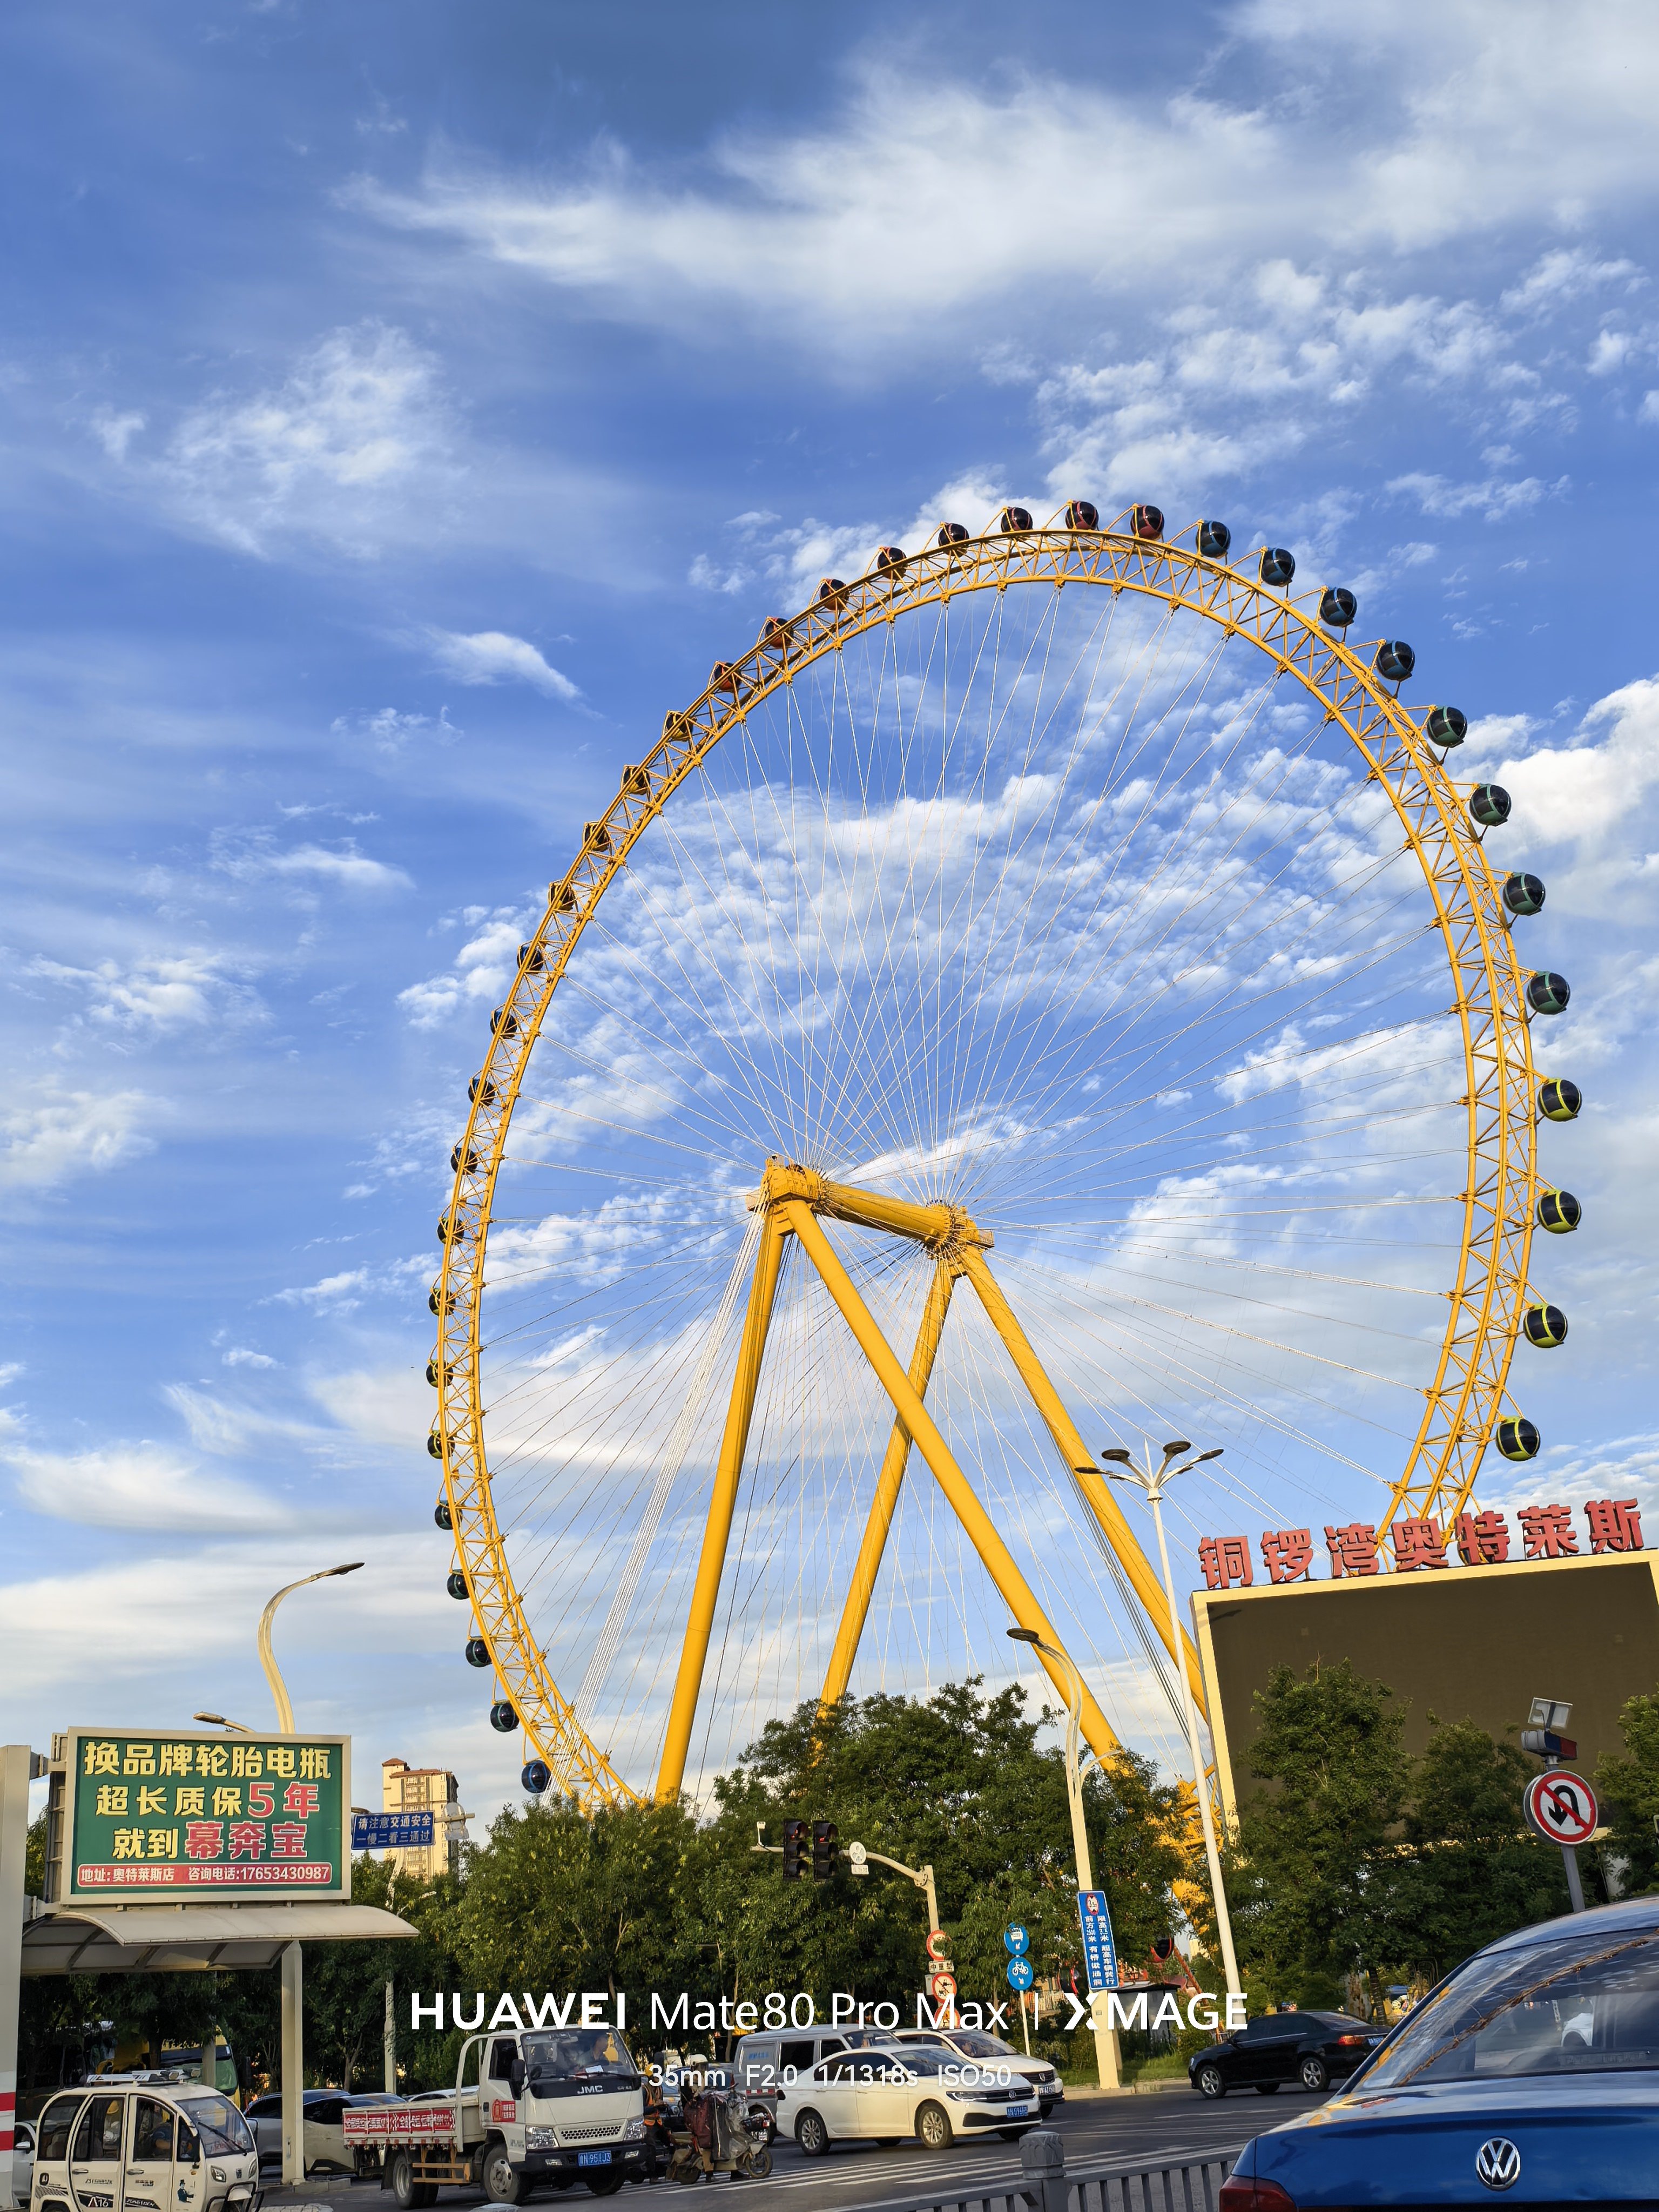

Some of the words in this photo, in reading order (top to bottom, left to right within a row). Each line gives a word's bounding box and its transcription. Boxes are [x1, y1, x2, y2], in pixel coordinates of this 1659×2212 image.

[1198, 1499, 1643, 1589] 铜锣湾奥特莱斯
[84, 1741, 332, 1779] 换品牌轮胎电瓶
[96, 1782, 320, 1819] 超长质保5年
[112, 1820, 308, 1859] 就到幕奔宝
[356, 1830, 430, 1845] 一慢二看三通过
[358, 1814, 431, 1830] 请注意交通安全
[577, 2085, 603, 2094] JMC
